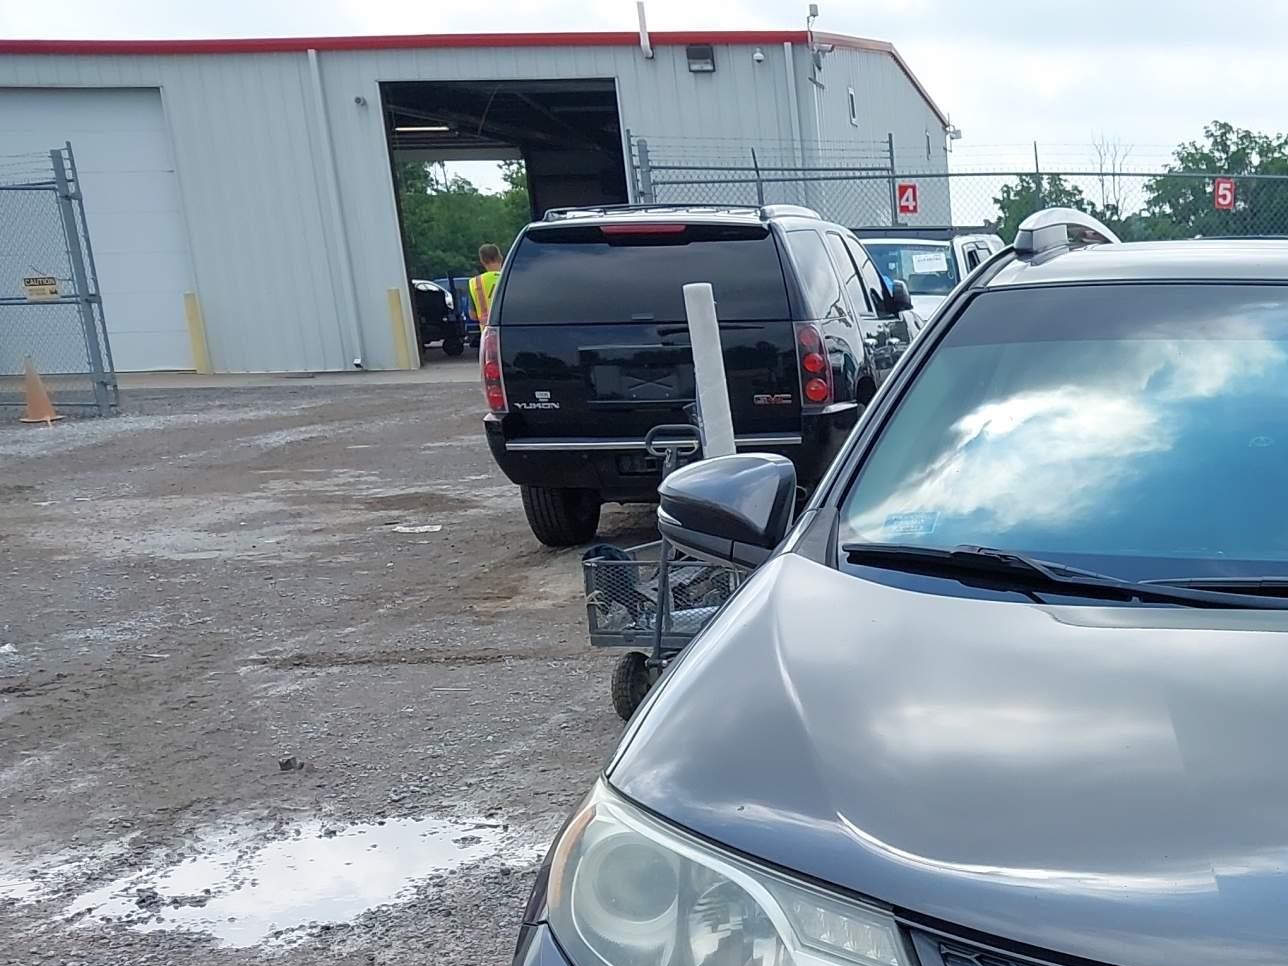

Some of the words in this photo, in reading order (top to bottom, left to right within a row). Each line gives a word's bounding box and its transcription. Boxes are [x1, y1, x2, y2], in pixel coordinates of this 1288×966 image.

[900, 187, 916, 211] 4
[1218, 183, 1232, 205] 5
[753, 394, 792, 404] GMC
